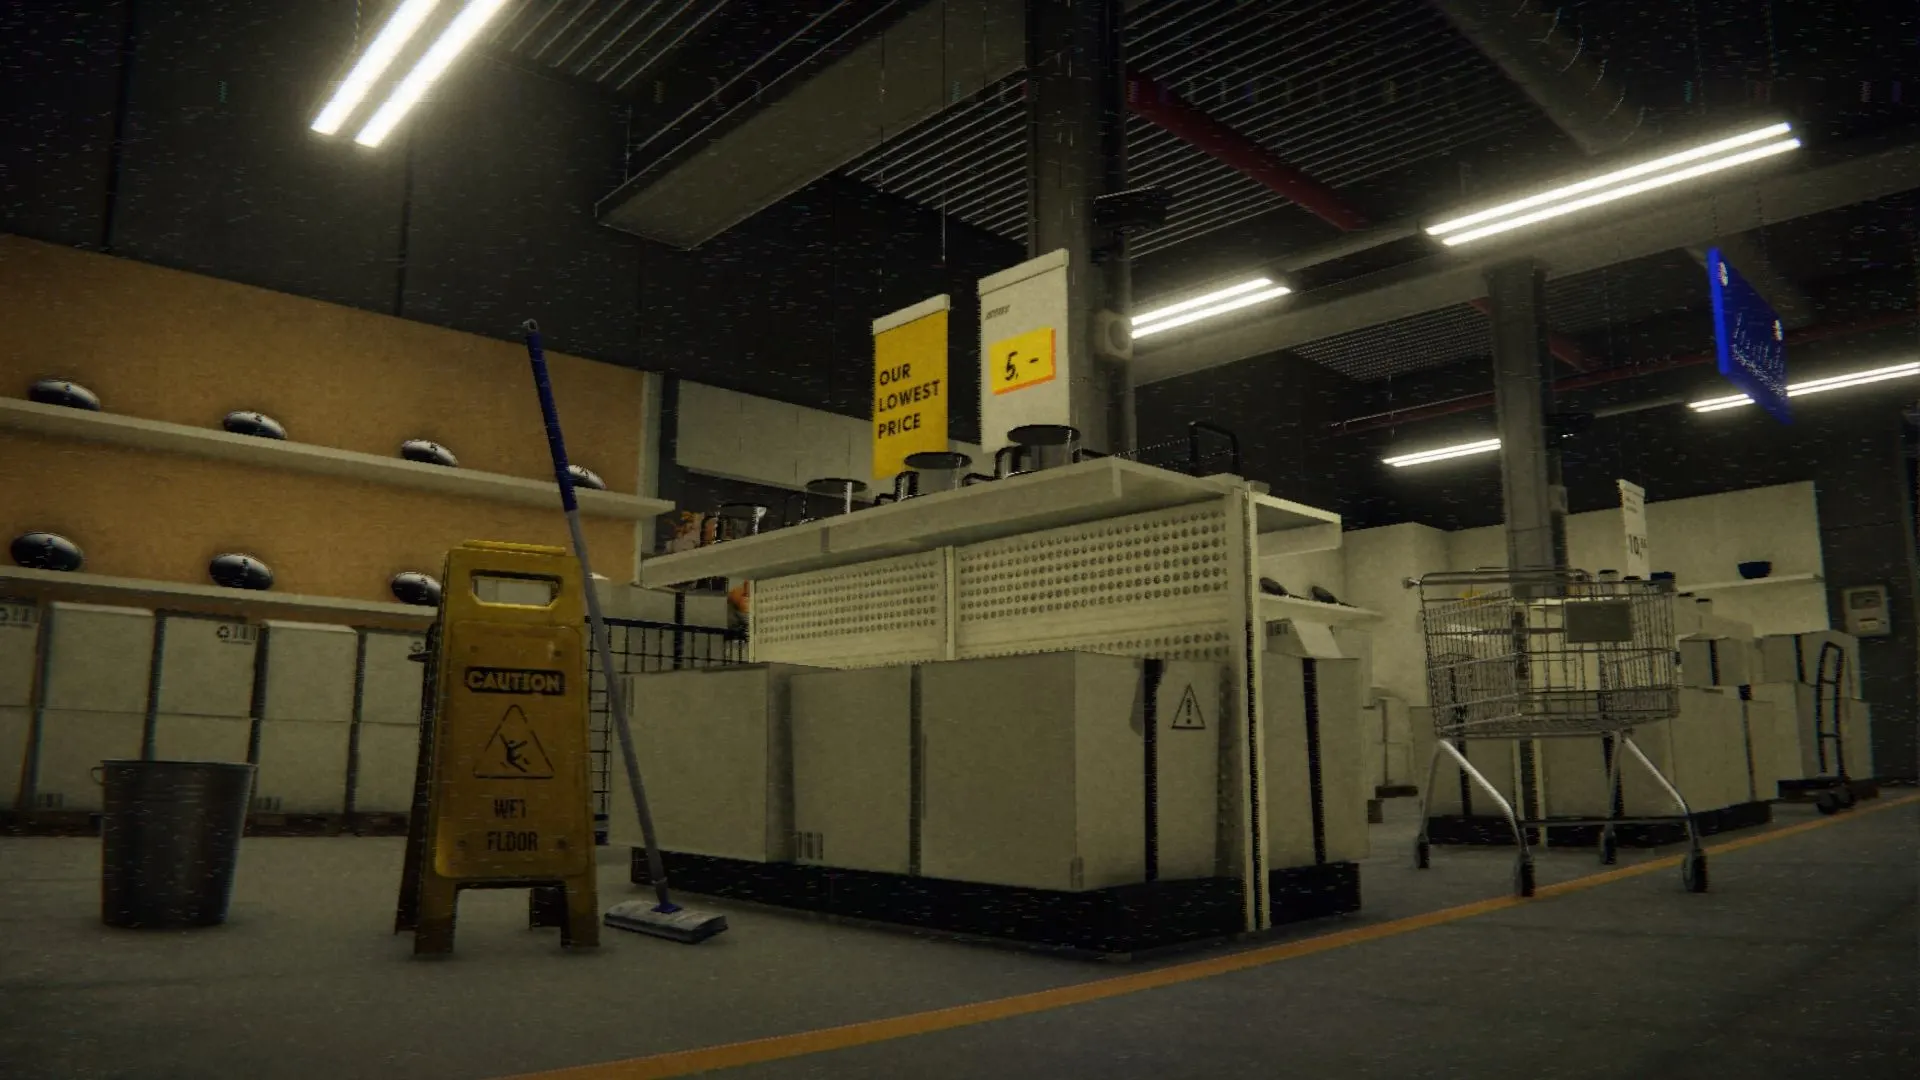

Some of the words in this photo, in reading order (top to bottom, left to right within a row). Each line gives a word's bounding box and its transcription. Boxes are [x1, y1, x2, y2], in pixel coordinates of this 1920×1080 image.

[879, 363, 911, 386] OUR
[879, 379, 940, 412] LOWEST
[878, 412, 921, 439] PRICE
[467, 670, 560, 691] CAUTION
[494, 799, 526, 819] WET
[487, 831, 538, 851] FLOOR
